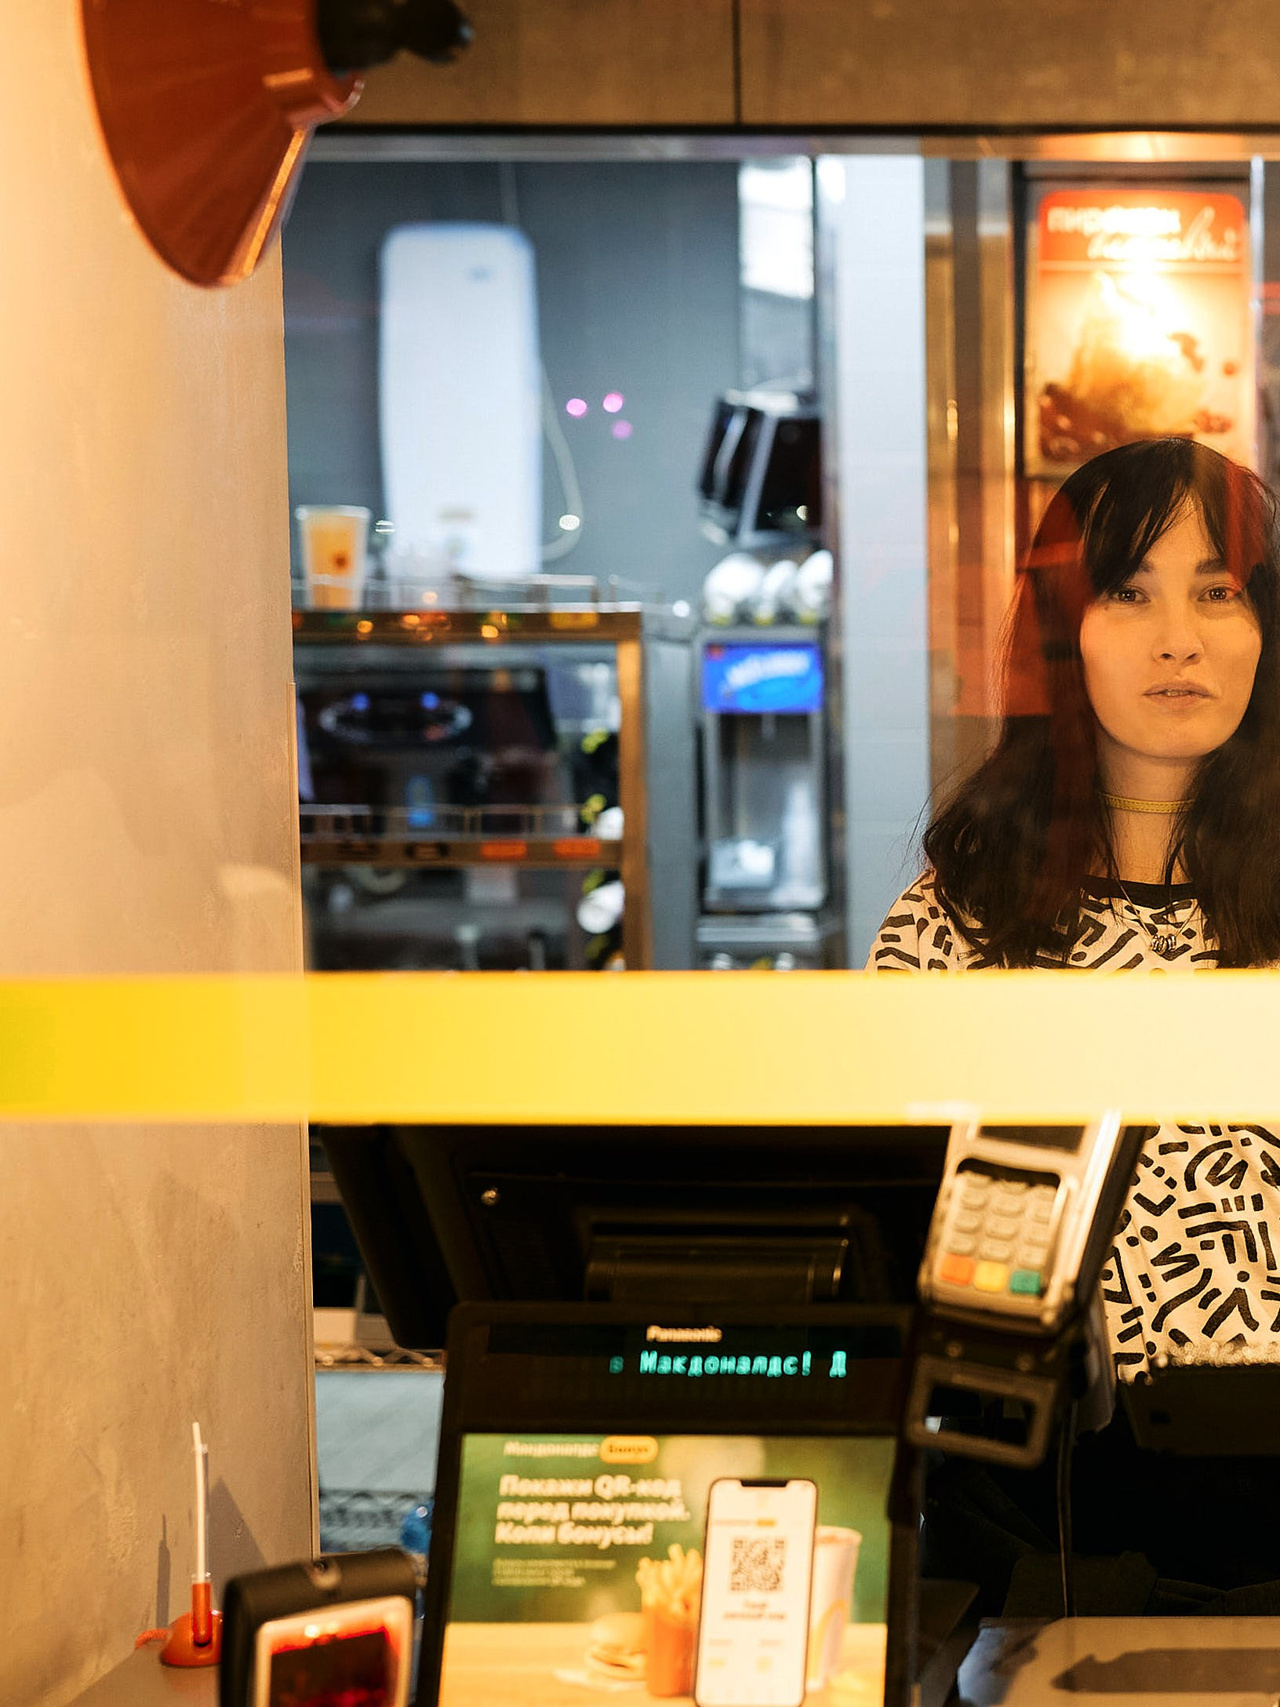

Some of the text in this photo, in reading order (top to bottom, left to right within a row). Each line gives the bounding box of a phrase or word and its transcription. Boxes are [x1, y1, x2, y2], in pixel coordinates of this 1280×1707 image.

[646, 1325, 722, 1343] Panasonic
[639, 1350, 812, 1378] Макдоналдс!
[828, 1350, 847, 1378] Д
[499, 1474, 593, 1497] Покажи
[497, 1501, 570, 1525] перед
